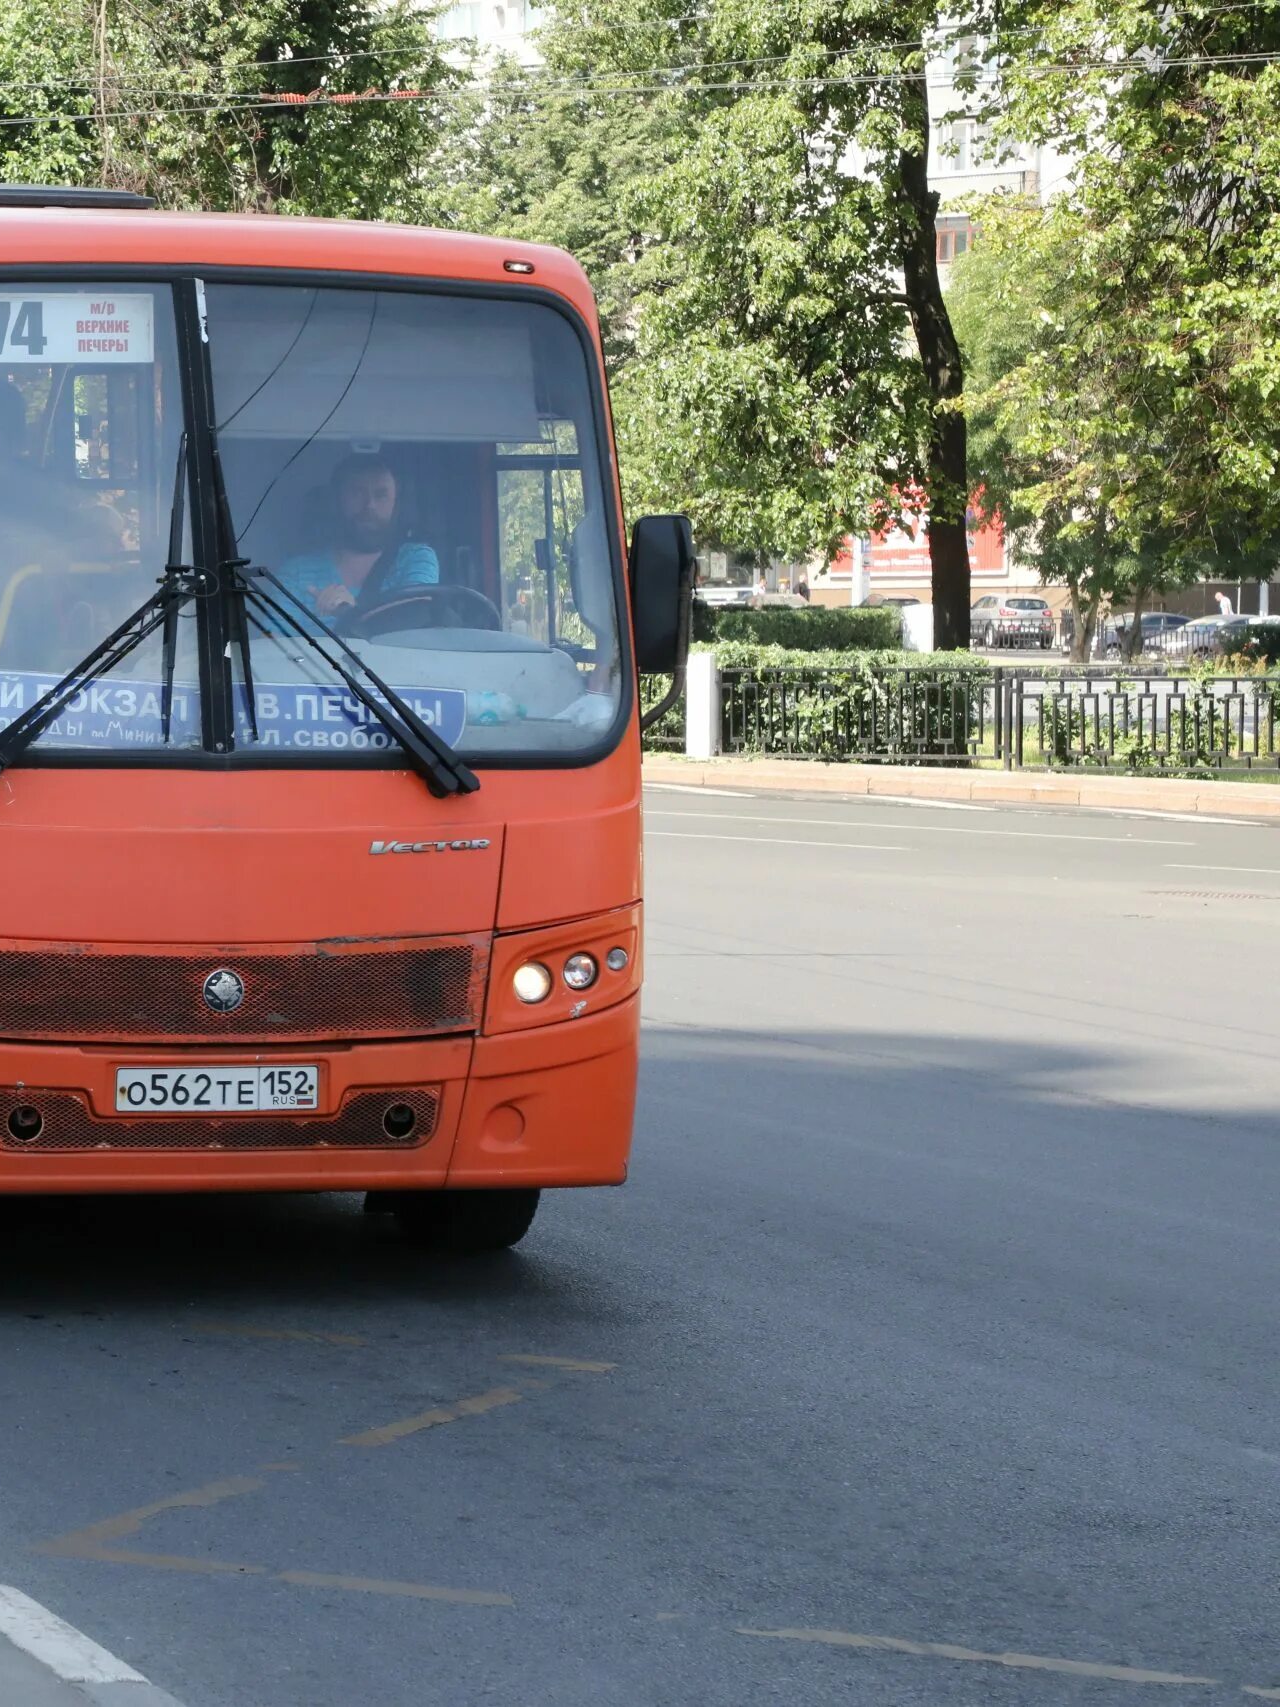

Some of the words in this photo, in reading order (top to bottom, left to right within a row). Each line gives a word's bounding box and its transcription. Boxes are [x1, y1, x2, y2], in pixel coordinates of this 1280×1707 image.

[76, 320, 130, 334] ВЕРХНИЕ
[77, 339, 129, 352] ПЕЧЕРЫ
[36, 684, 187, 721] ВОКЗАЛ
[127, 1073, 254, 1105] О562ТЕ
[263, 1070, 309, 1095] 152
[272, 1096, 296, 1105] RUS
